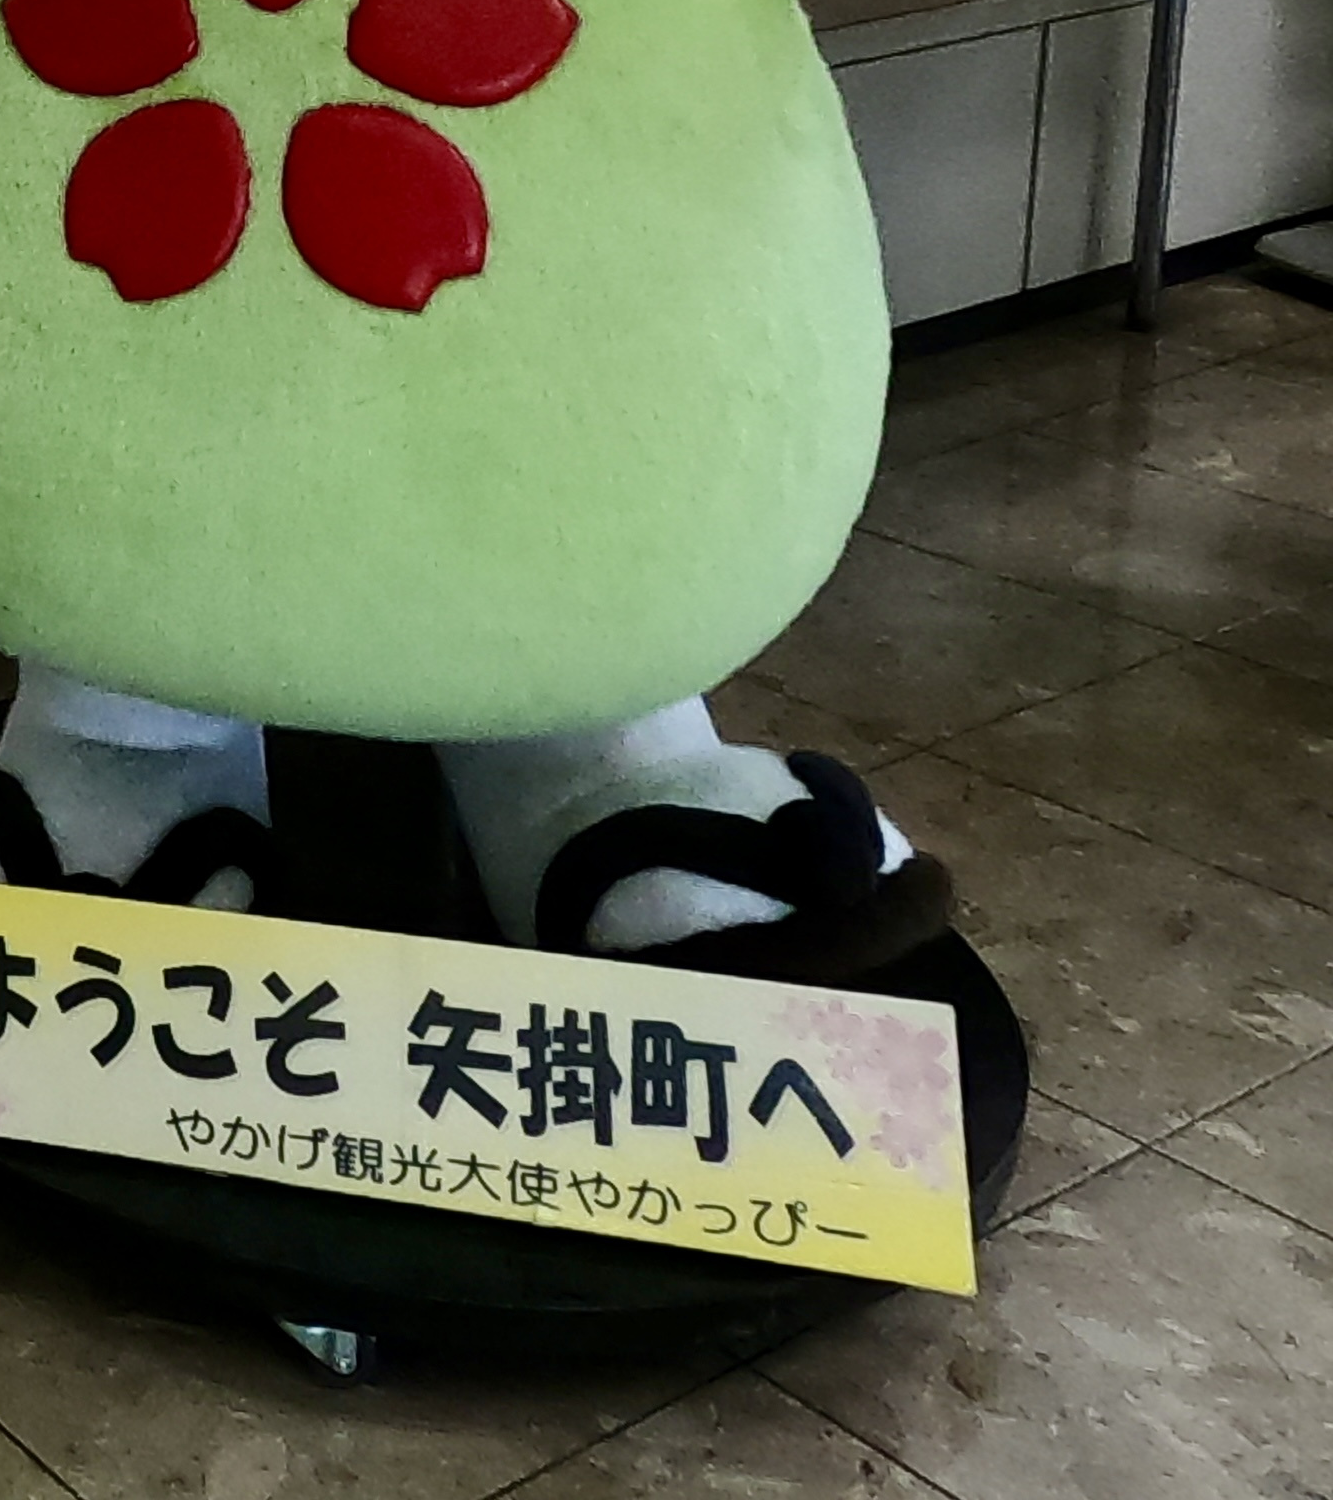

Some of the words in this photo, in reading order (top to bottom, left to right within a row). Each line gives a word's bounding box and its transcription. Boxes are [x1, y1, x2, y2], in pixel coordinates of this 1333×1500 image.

[405, 989, 856, 1163] 矢掛町へ
[165, 1105, 870, 1247] やかげ観光大使やかっぴー
